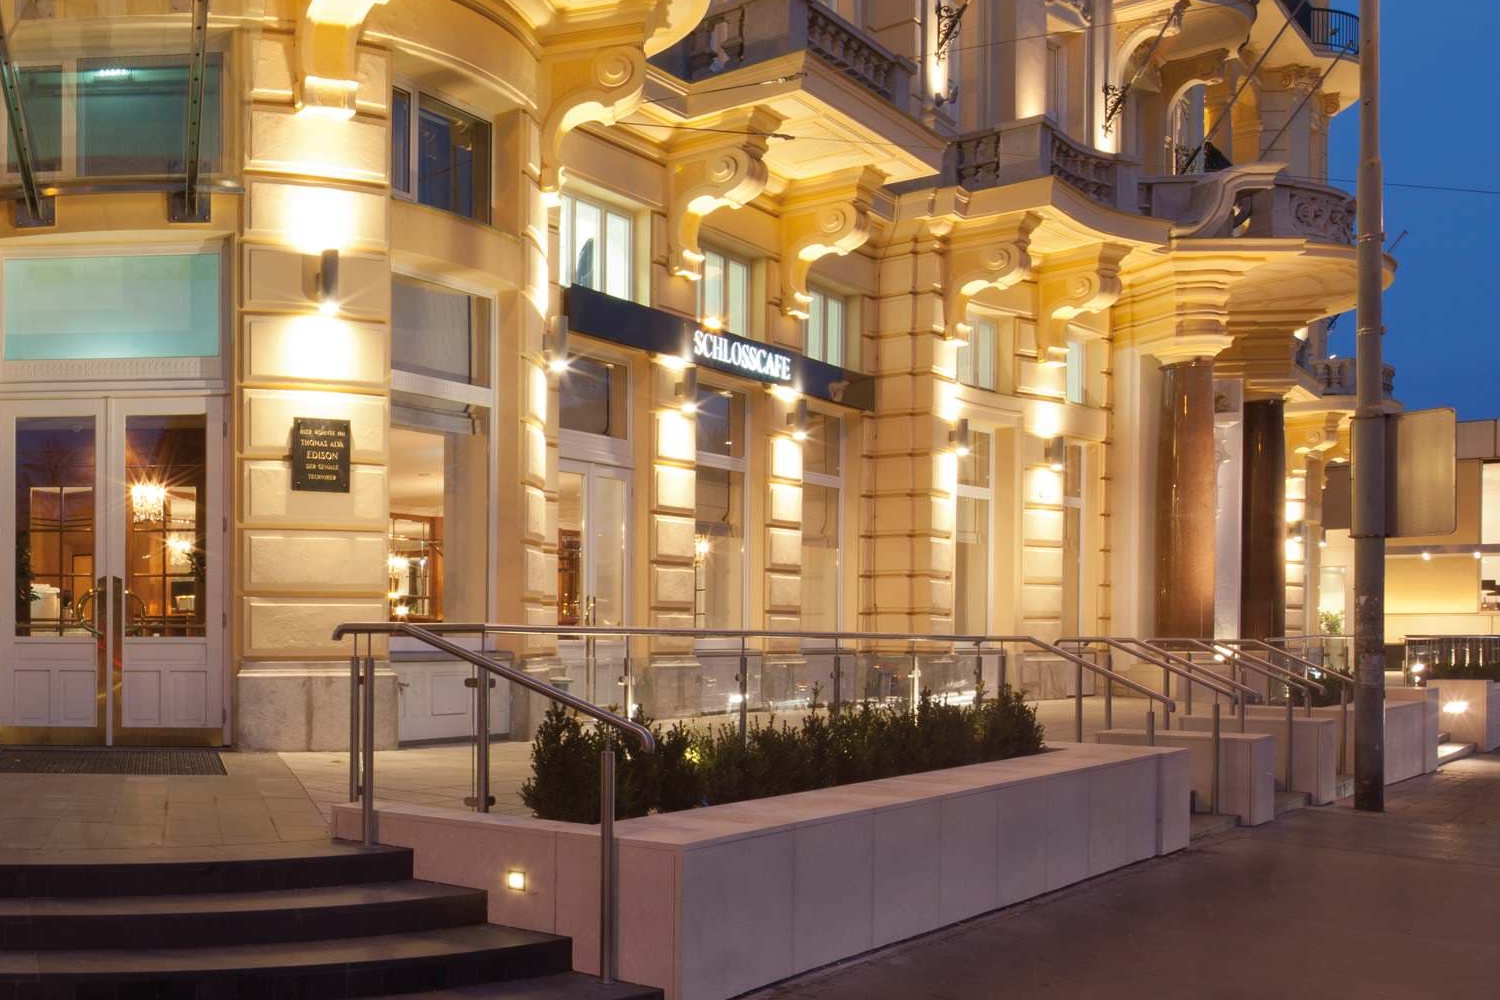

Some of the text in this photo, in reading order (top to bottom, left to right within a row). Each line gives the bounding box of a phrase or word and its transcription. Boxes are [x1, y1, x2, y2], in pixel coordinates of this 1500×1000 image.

[693, 330, 792, 381] SCHLOSSCAFE
[300, 439, 328, 447] THOMAS
[306, 450, 339, 460] EDISON
